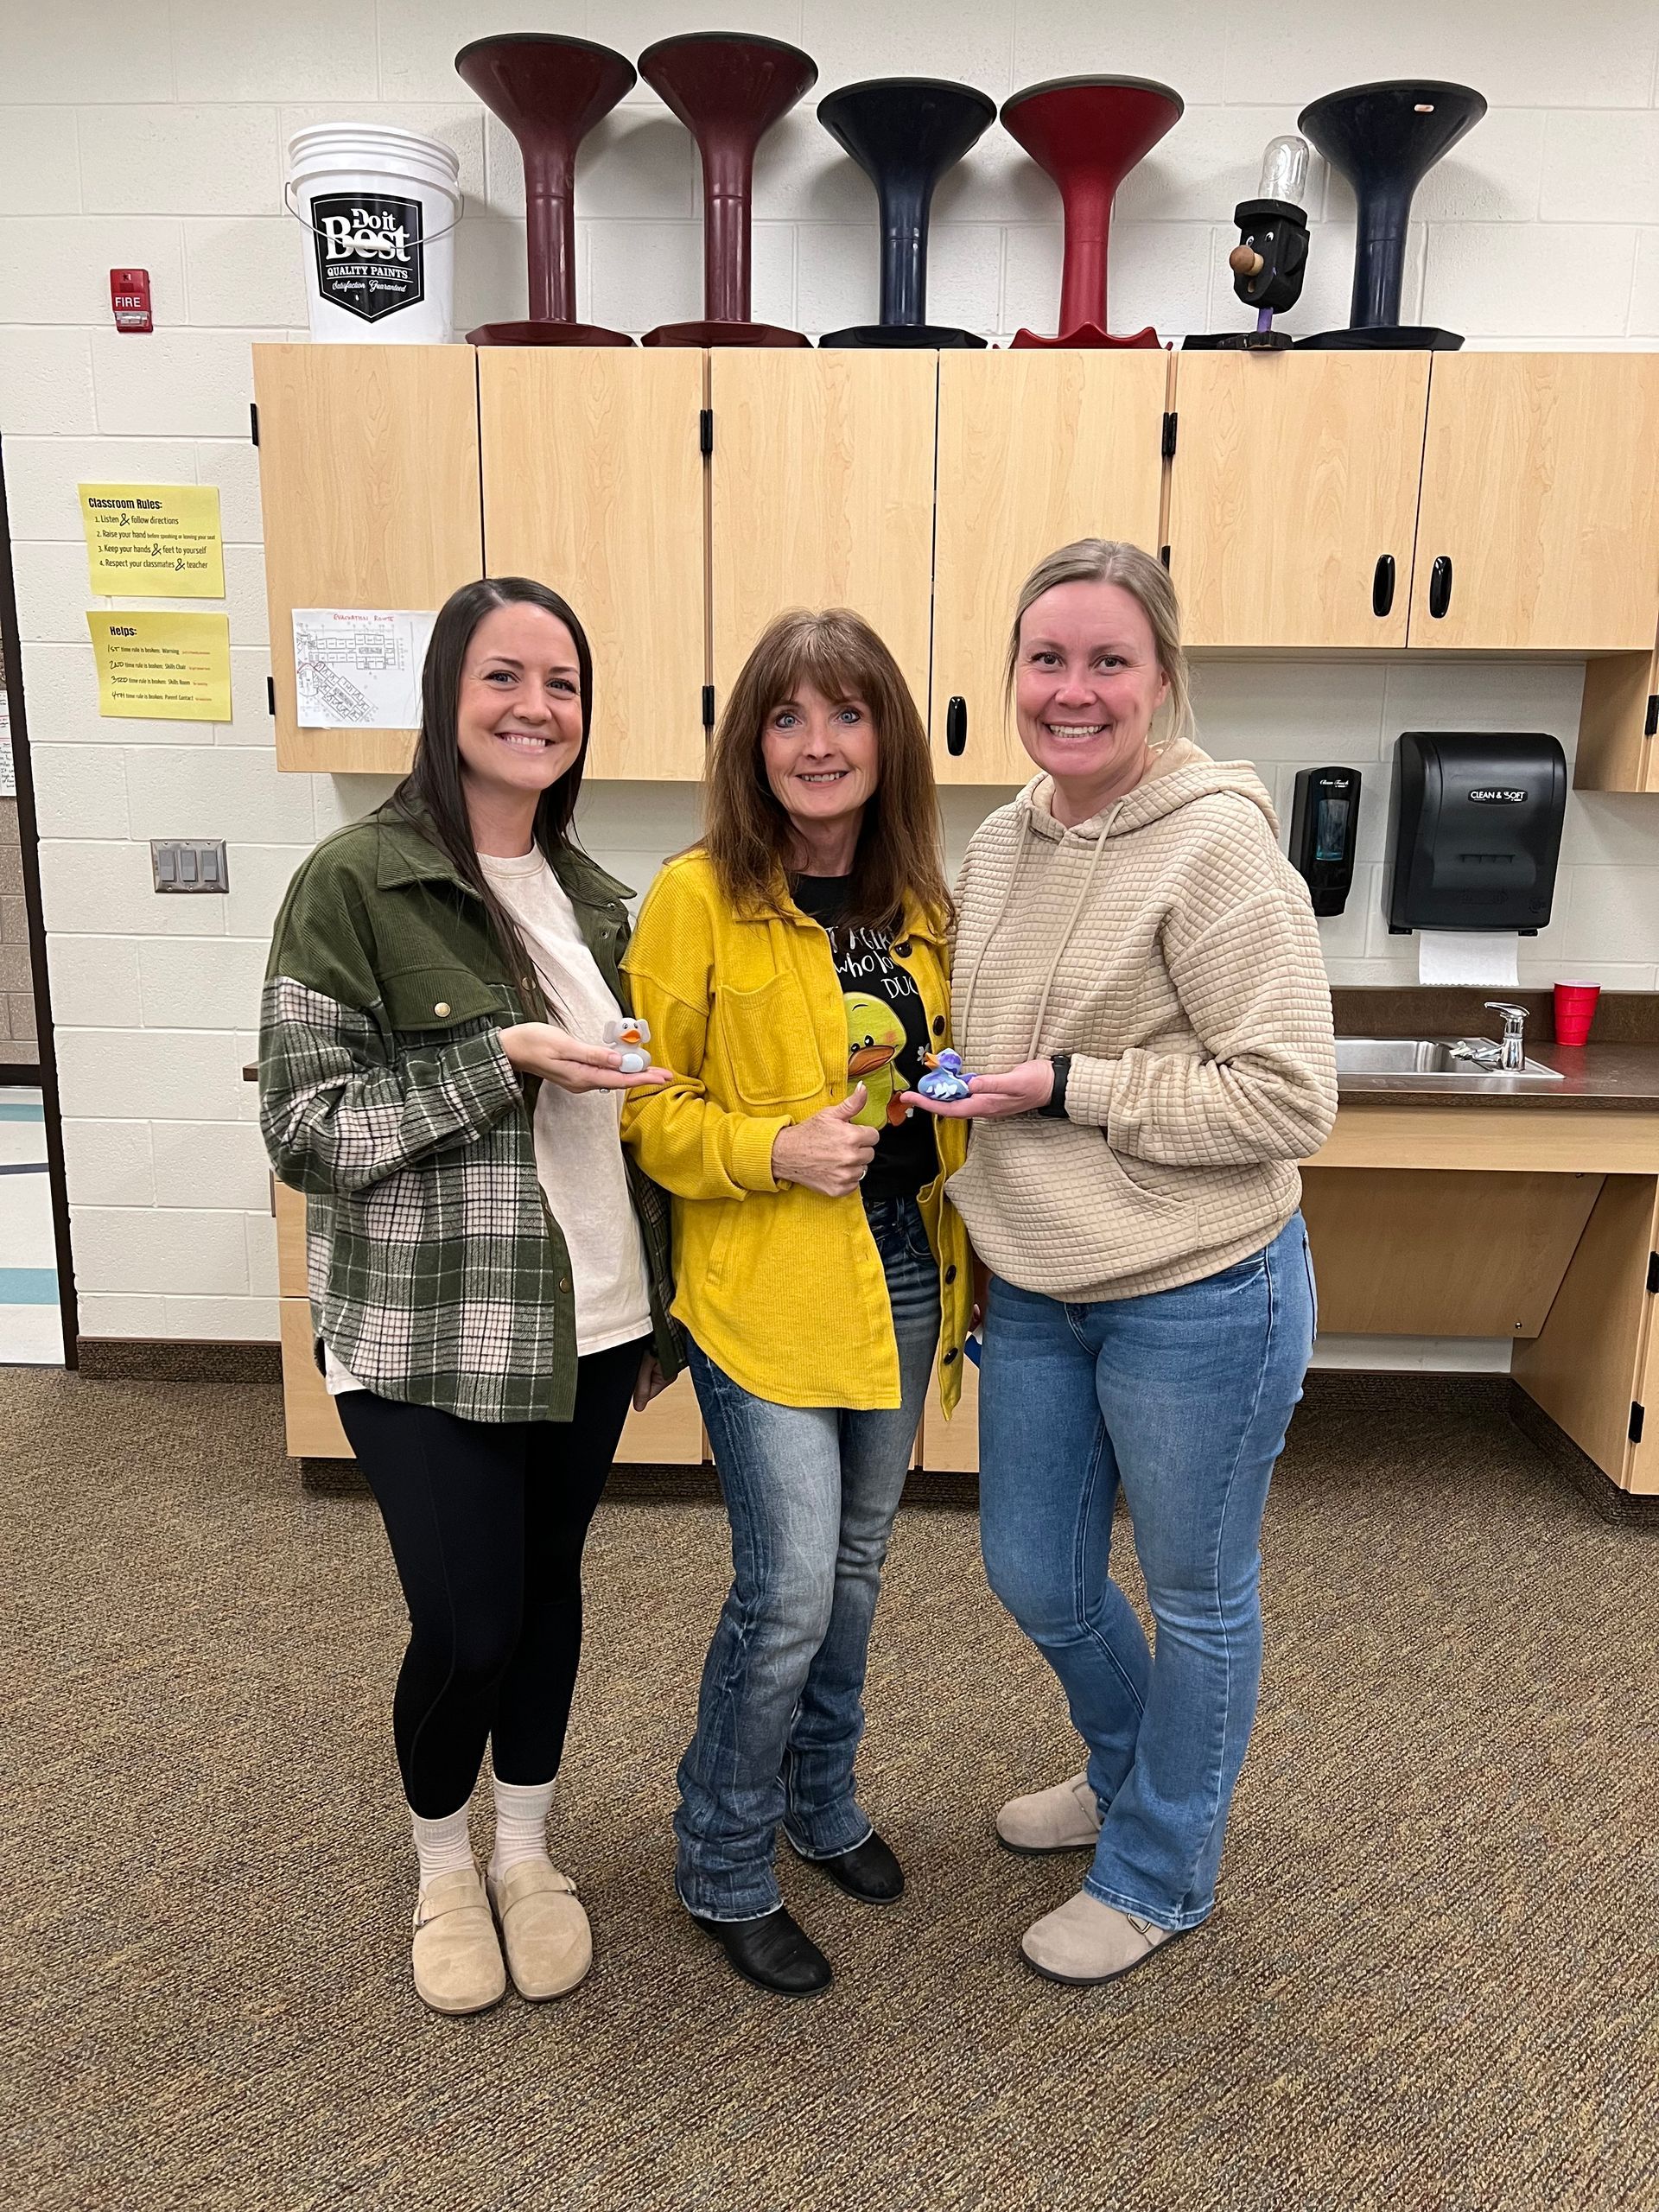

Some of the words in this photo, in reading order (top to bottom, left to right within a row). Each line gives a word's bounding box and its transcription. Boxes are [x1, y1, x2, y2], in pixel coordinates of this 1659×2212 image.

[351, 208, 381, 228] Do
[382, 211, 396, 231] it
[321, 215, 411, 262] Best
[327, 266, 368, 276] QUALITY
[371, 268, 408, 279] PAINTS
[332, 280, 365, 292] Satisfaction
[369, 280, 406, 292] Guaranteed
[115, 297, 141, 307] FIRE
[88, 498, 135, 509] Classroom
[137, 499, 162, 509] Rules:
[119, 513, 130, 526] &
[105, 545, 118, 554] Keep
[151, 543, 162, 556] &
[183, 546, 207, 555] yourself
[105, 559, 128, 569] Respect
[175, 558, 185, 571] &
[110, 626, 137, 637] Helps:
[835, 952, 874, 977] who
